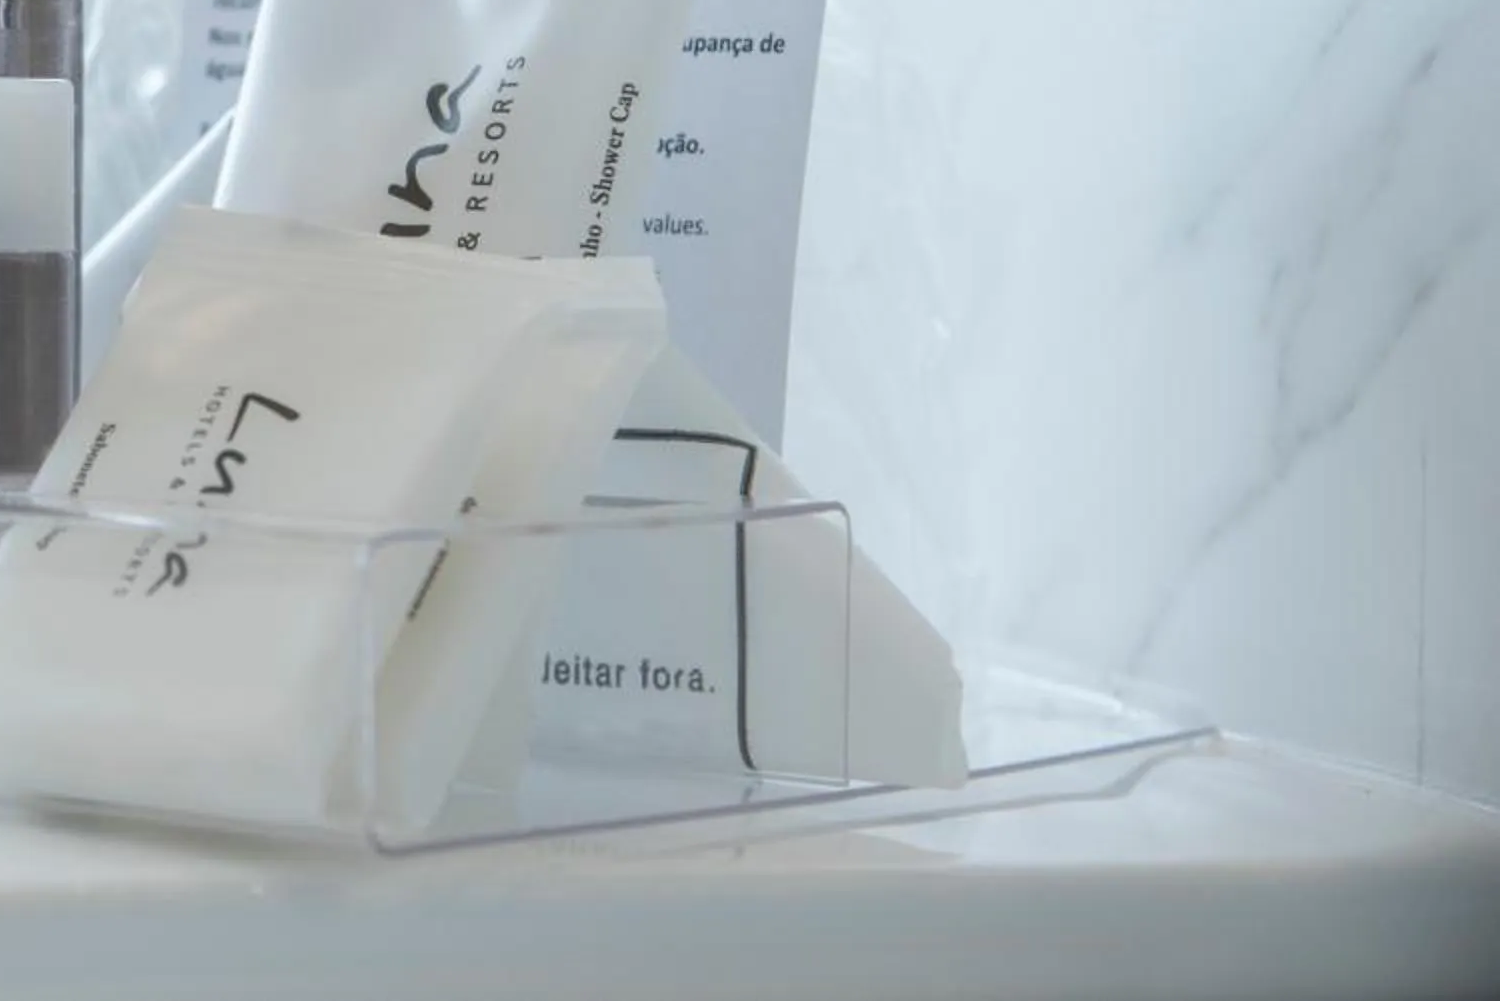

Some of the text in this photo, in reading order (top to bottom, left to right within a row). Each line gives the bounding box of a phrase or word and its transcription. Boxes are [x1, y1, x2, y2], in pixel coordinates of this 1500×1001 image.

[759, 32, 786, 54] de
[457, 56, 526, 251] & RESORTS
[589, 126, 626, 207] Shower
[609, 81, 640, 123] Cap
[643, 213, 709, 236] values.
[181, 385, 230, 467] HOTELS
[639, 658, 715, 693] fora.
